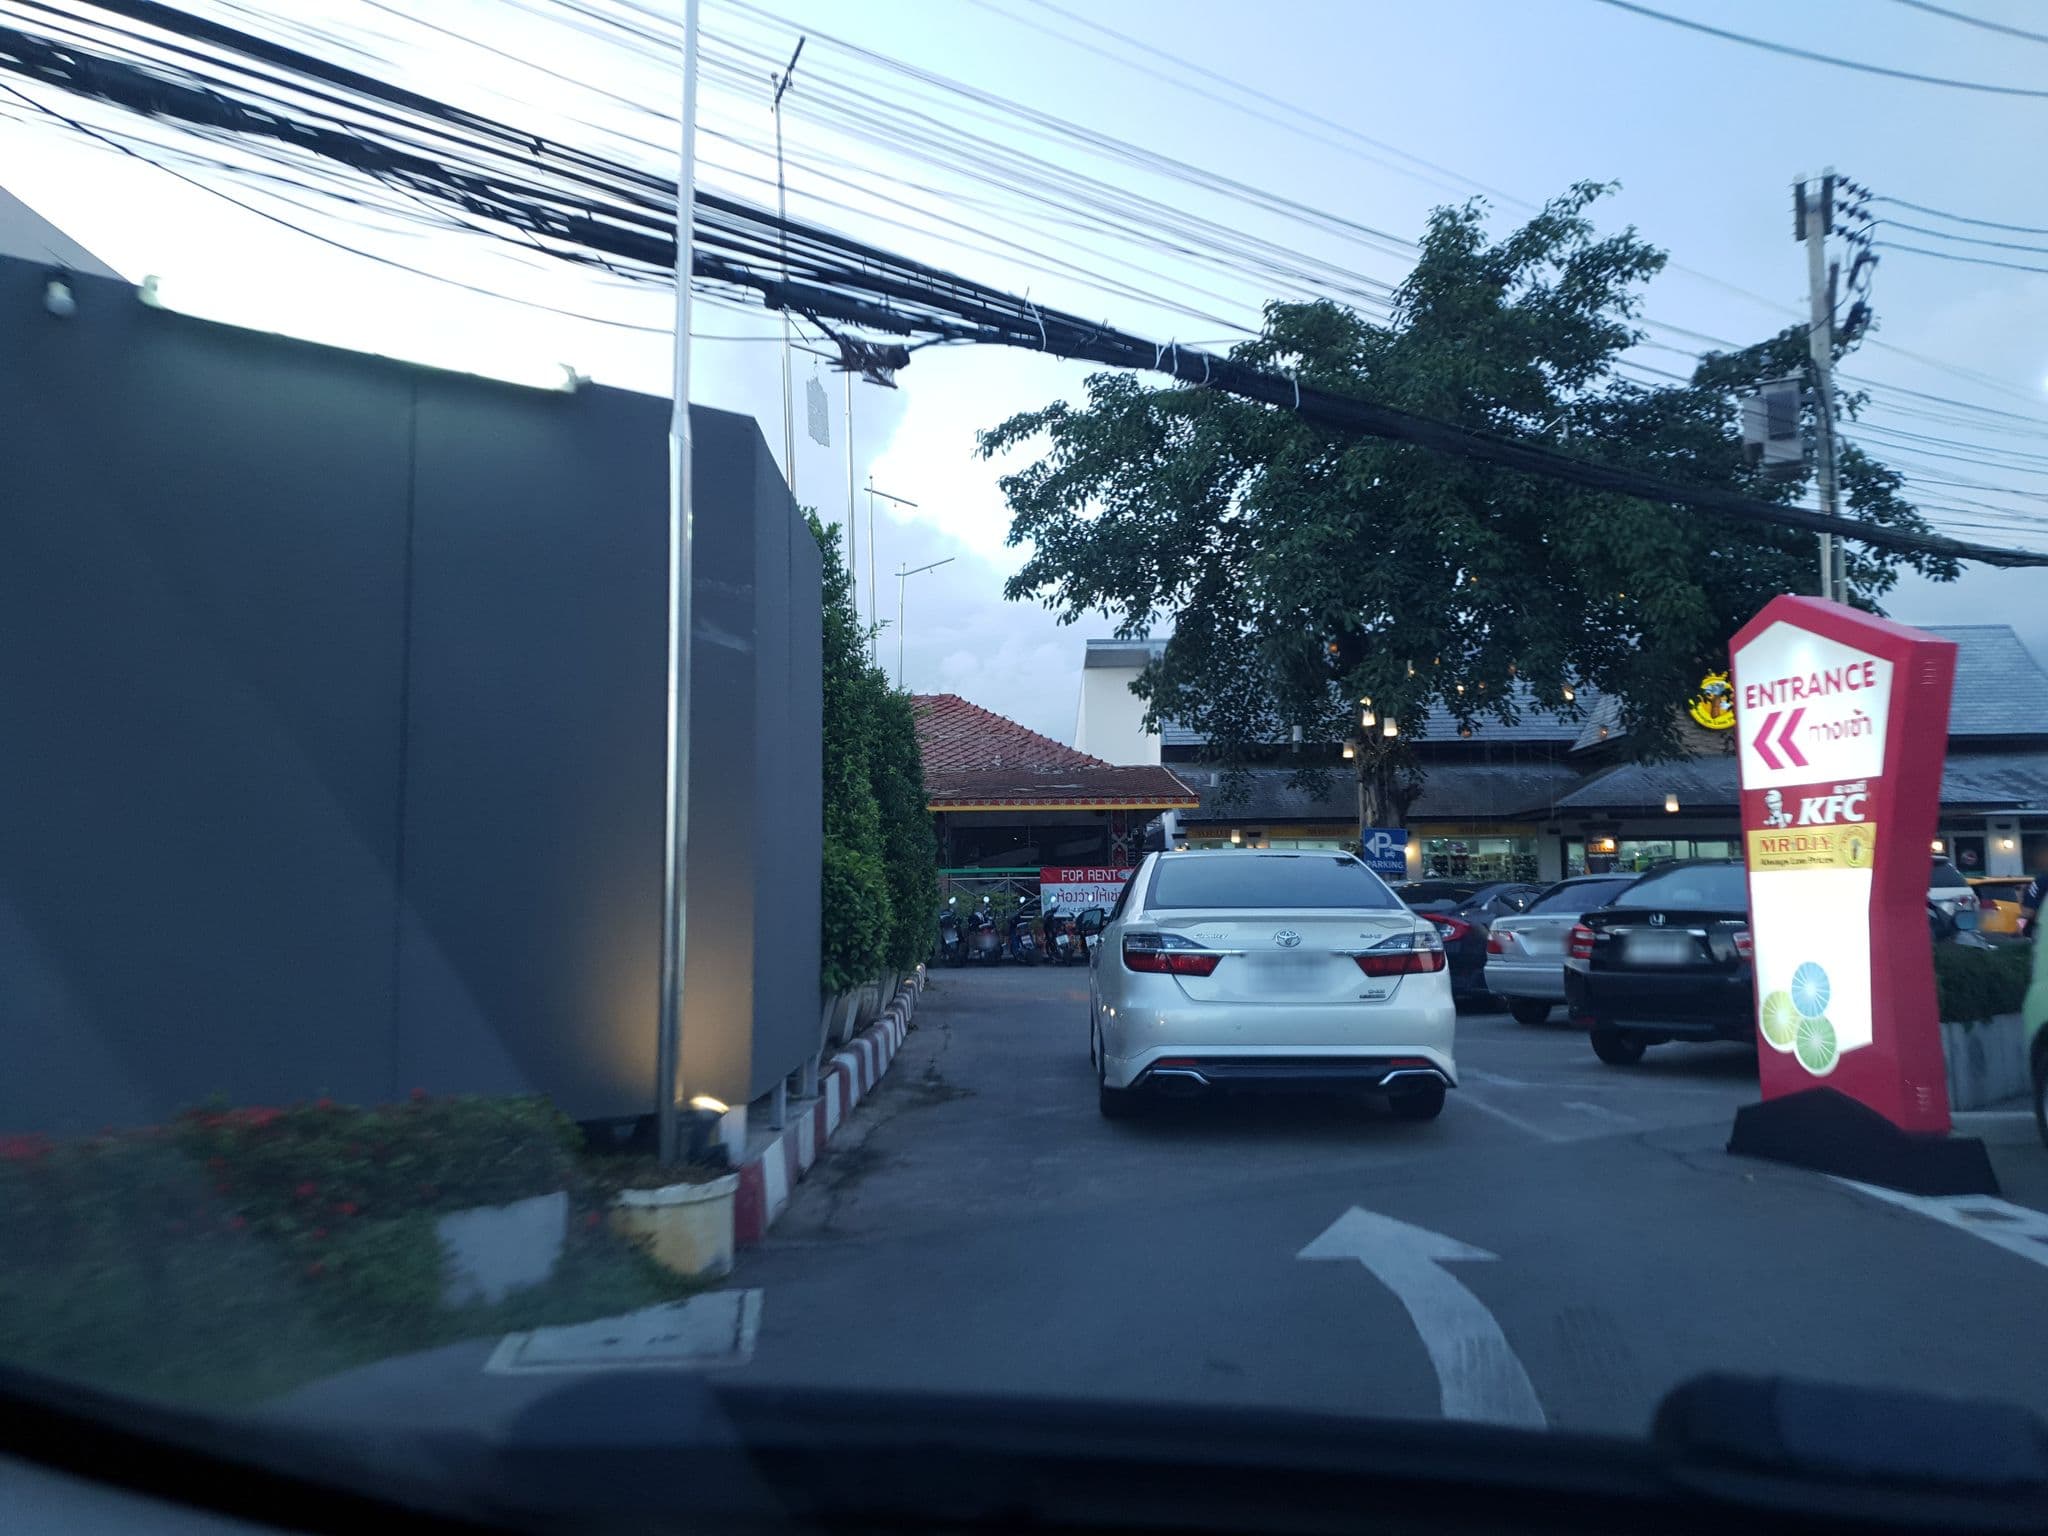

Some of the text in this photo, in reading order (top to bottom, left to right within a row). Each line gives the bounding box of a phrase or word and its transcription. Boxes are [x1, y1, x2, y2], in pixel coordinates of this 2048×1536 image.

[1745, 660, 1877, 709] ENTRANCE
[1797, 793, 1867, 825] KFC
[1374, 832, 1392, 857] P
[1061, 869, 1118, 881] FOR RENT
[1366, 860, 1404, 869] PARKING
